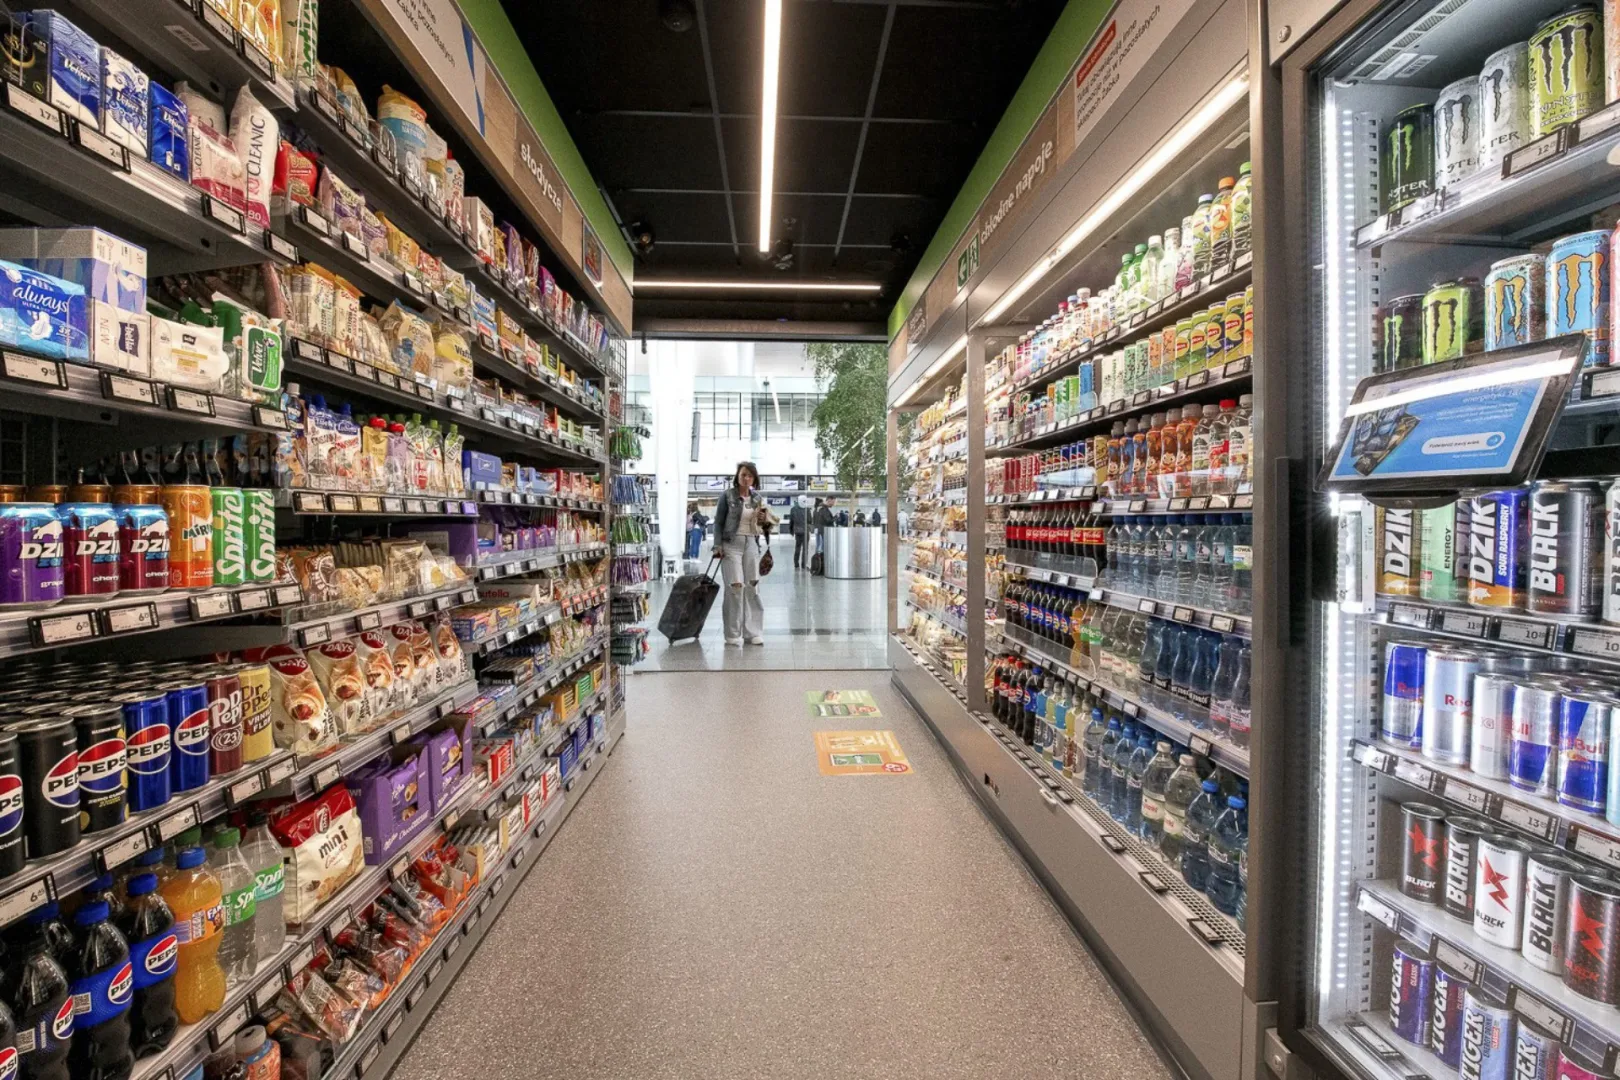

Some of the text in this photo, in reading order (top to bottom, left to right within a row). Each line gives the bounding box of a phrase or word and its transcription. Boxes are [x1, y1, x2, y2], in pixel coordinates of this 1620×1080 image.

[248, 115, 266, 177] CLEANIC
[520, 143, 562, 213] słodycze
[980, 140, 1054, 245] chłodne napoje
[13, 284, 69, 315] always
[124, 324, 135, 351] bella
[216, 494, 244, 580] Sprite
[251, 489, 275, 578] Sprite
[1384, 507, 1412, 578] DZIK
[1444, 527, 1453, 570] ENERGY
[1469, 496, 1496, 585] DZIK
[1498, 503, 1511, 577] SOUR RASPBERRY
[1531, 498, 1560, 593] BLACK
[325, 641, 355, 653] DAYS
[178, 725, 211, 743] PEP
[208, 697, 243, 729] Pep
[78, 754, 127, 777] PEPS
[126, 738, 171, 760] PEPS
[318, 824, 350, 860] mini
[1404, 874, 1437, 889] BLACK
[1446, 833, 1470, 907] BLACK
[1529, 874, 1557, 955] BLACK
[148, 944, 178, 966] PEPS
[1432, 974, 1448, 1056] TIGER
[0, 1057, 18, 1077] PSI
